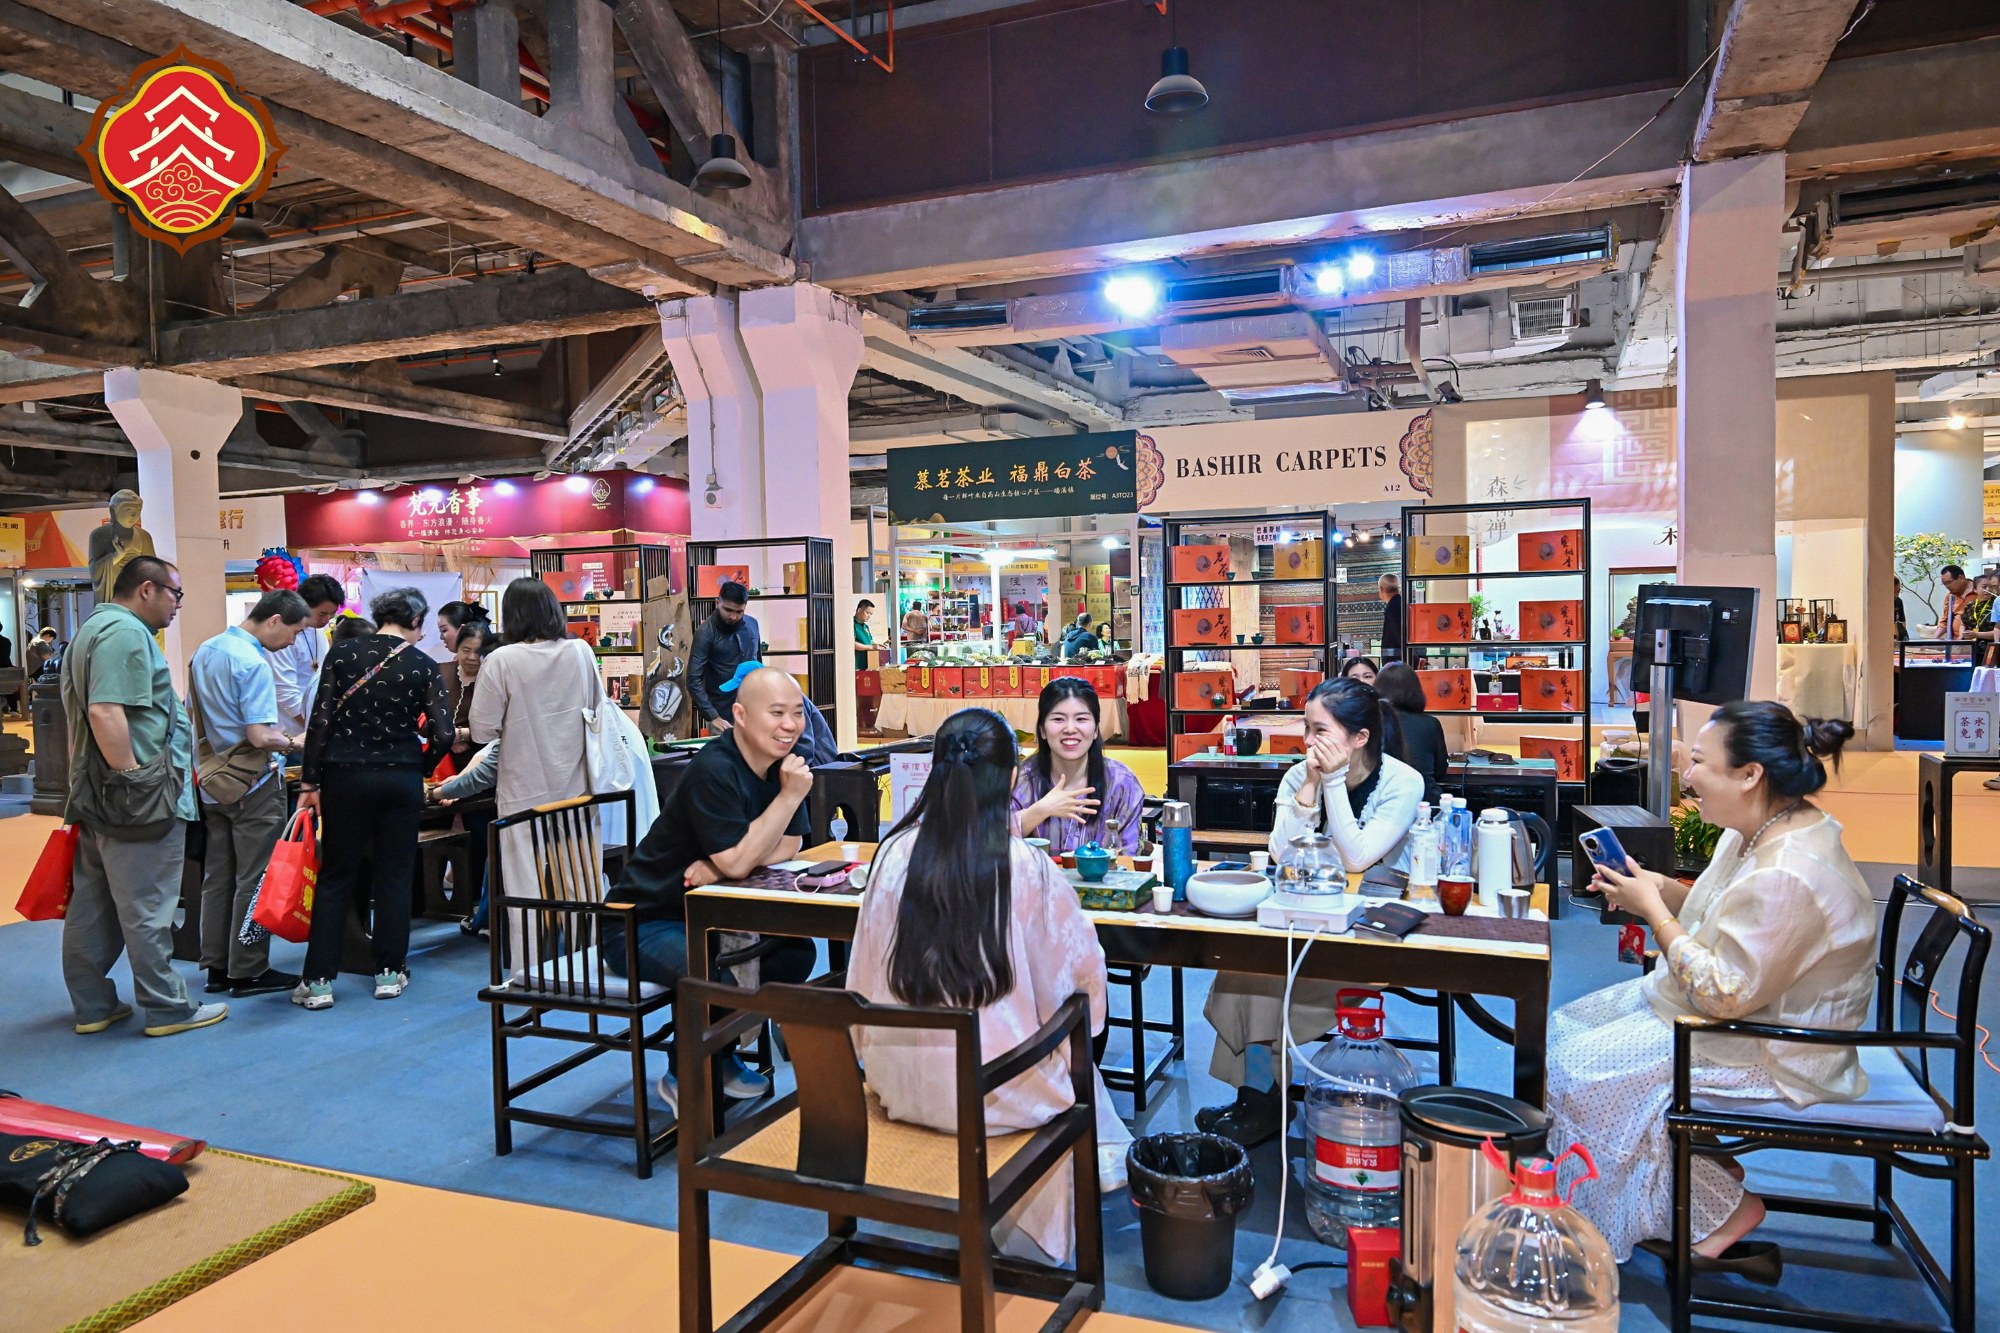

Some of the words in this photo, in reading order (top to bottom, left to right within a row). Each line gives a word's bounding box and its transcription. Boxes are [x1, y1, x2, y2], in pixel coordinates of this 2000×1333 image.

[1009, 457, 1097, 483] 福鼎白茶
[1176, 454, 1262, 478] BASHIR
[1276, 446, 1387, 472] CARPETS
[1383, 484, 1400, 492] A12
[1213, 551, 1229, 578] 岩茶
[1214, 613, 1230, 640] 岩茶
[1960, 716, 1986, 728] 茶水
